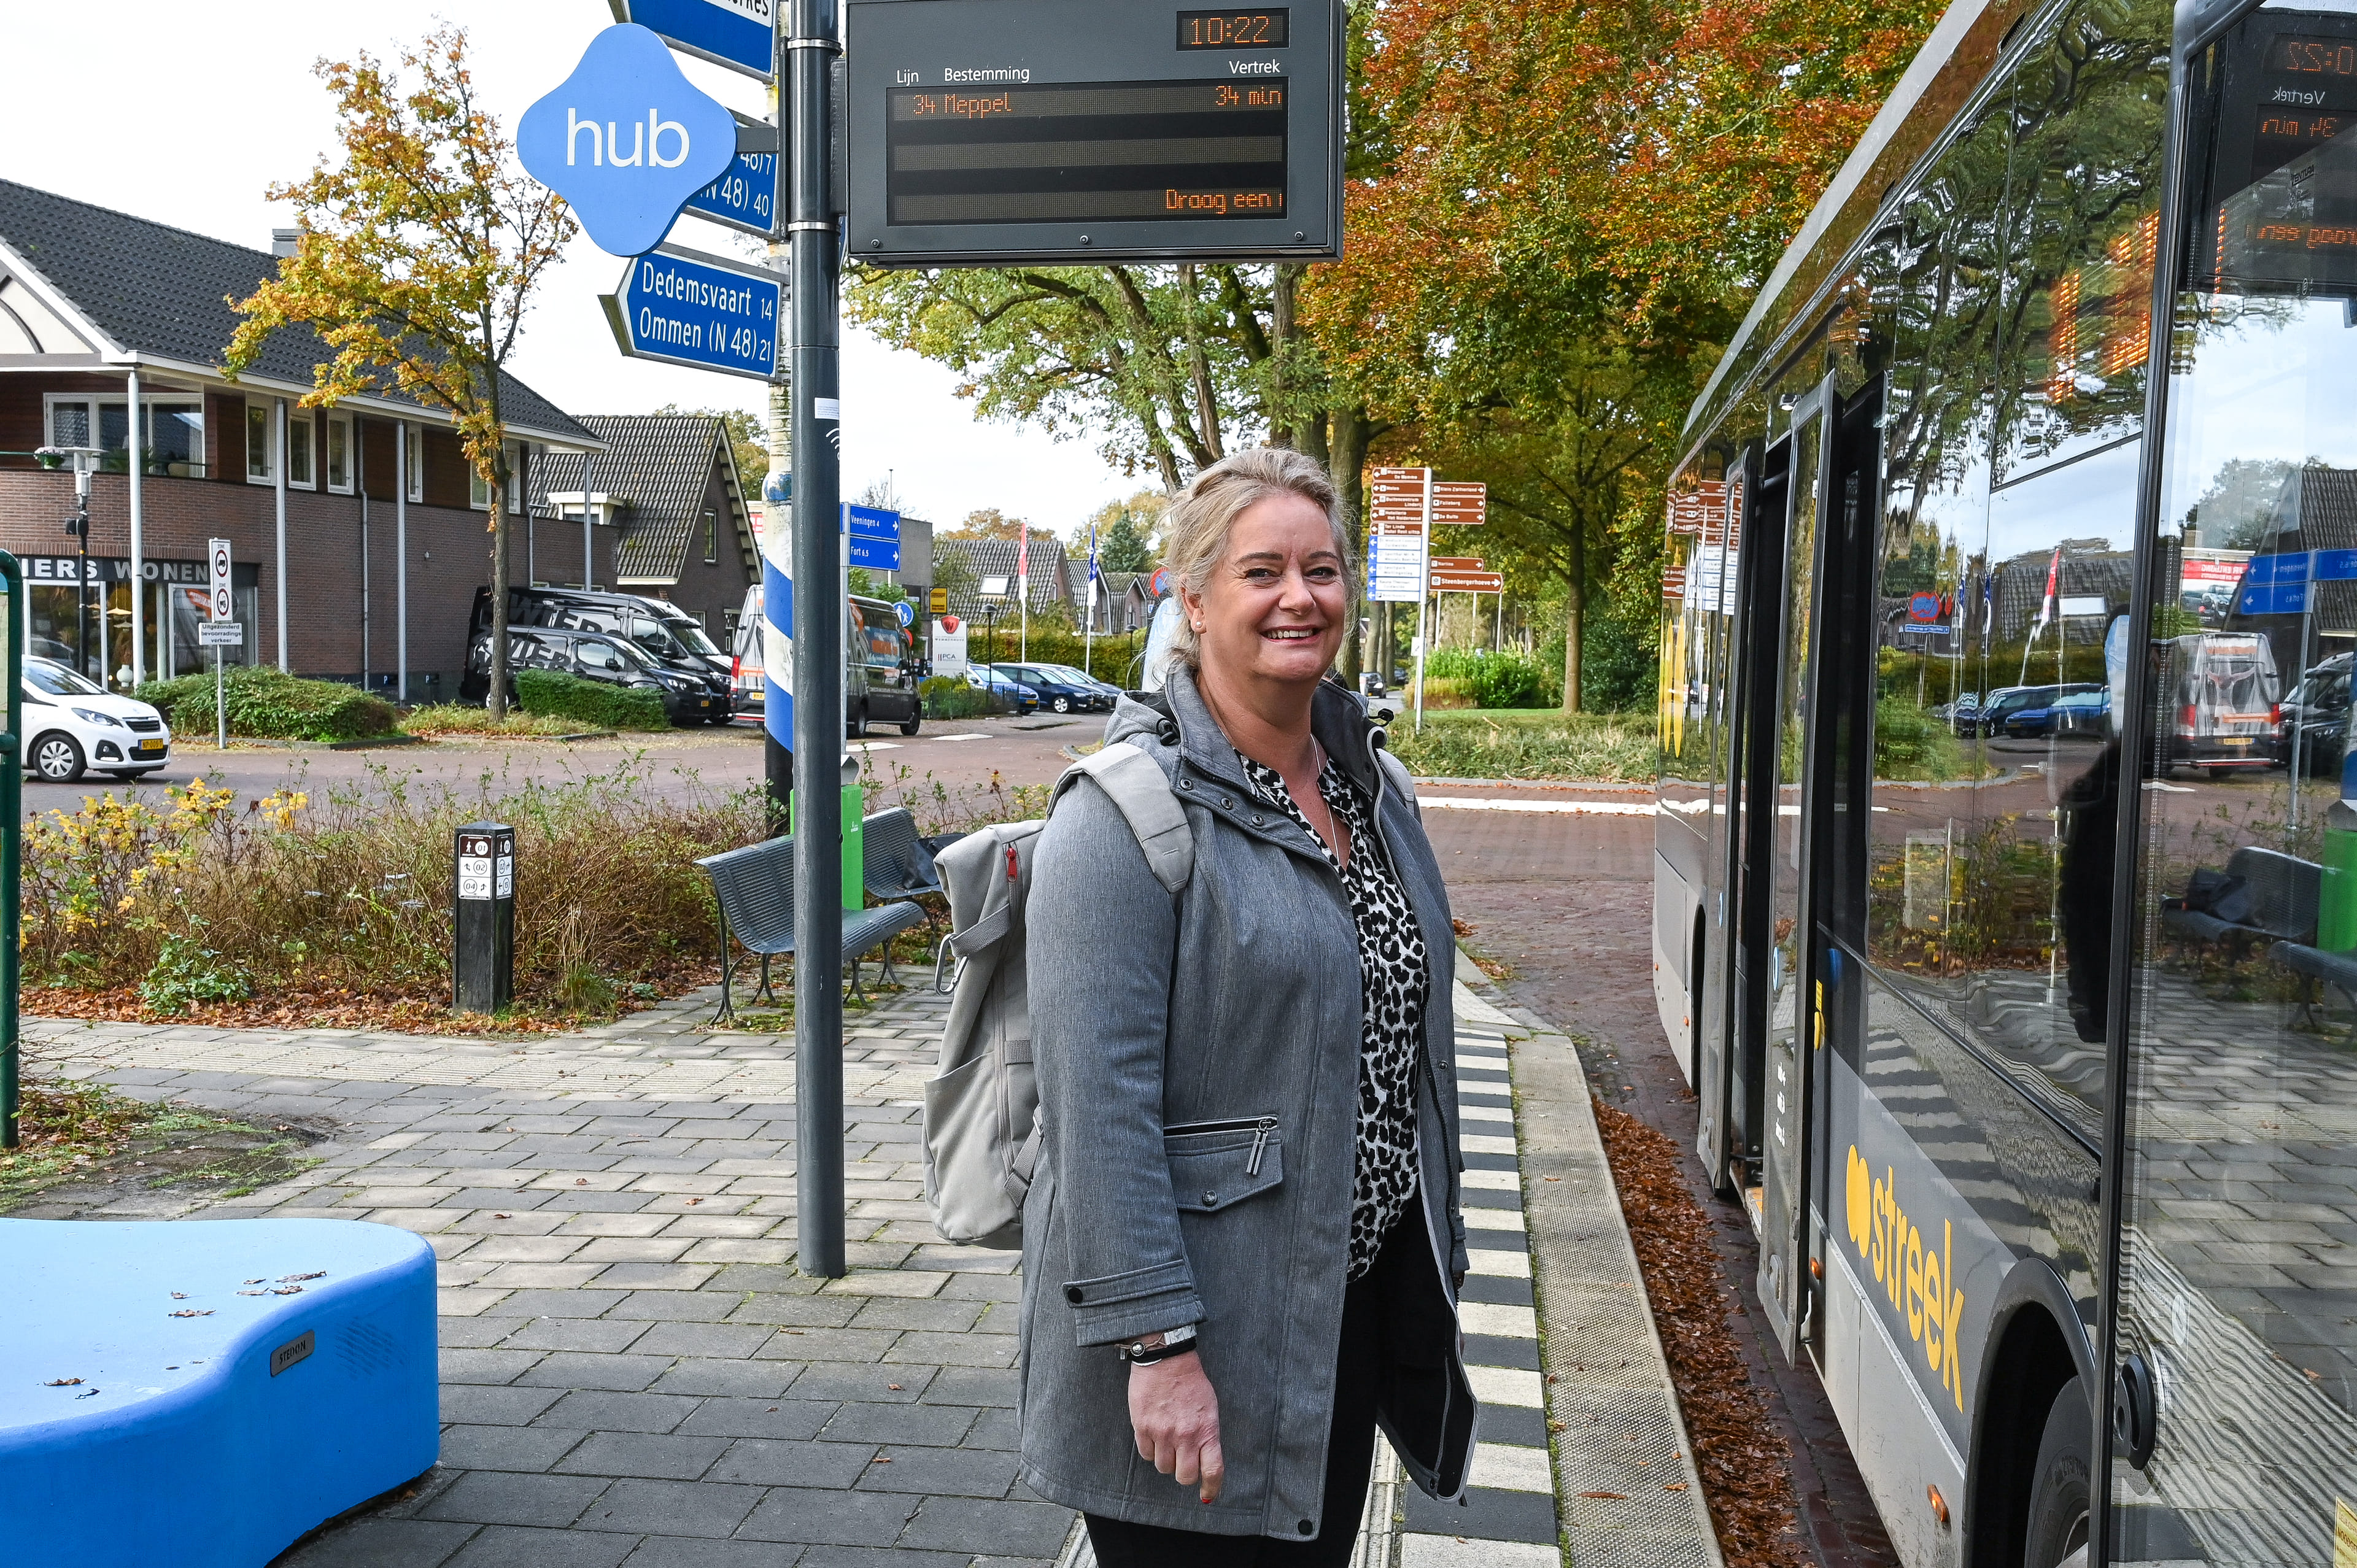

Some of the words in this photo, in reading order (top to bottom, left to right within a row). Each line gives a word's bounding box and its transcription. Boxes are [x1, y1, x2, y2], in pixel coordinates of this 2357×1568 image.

[1191, 16, 1269, 44] 10:22
[896, 69, 919, 86] Lijn
[944, 66, 1030, 83] Bestemming
[1228, 58, 1280, 74] Vertrek
[913, 94, 936, 115] 34
[945, 92, 1012, 119] Meppel
[1215, 85, 1240, 106] 34
[1248, 87, 1282, 105] min
[566, 107, 690, 168] hub
[765, 155, 772, 175] 7
[721, 176, 749, 211] 48)
[754, 193, 769, 217] 40
[1234, 193, 1272, 207] een
[643, 261, 751, 316] Dedemsvaart
[761, 298, 772, 320] 14
[639, 307, 702, 349] Ommen
[709, 320, 726, 353] (N
[730, 327, 757, 360] 48)
[759, 339, 771, 362] 21
[850, 514, 876, 529] Veeningen
[850, 546, 861, 556] Fort
[17, 558, 98, 579] IERS
[114, 561, 208, 582] WONEN
[1872, 1165, 1965, 1413] streek
